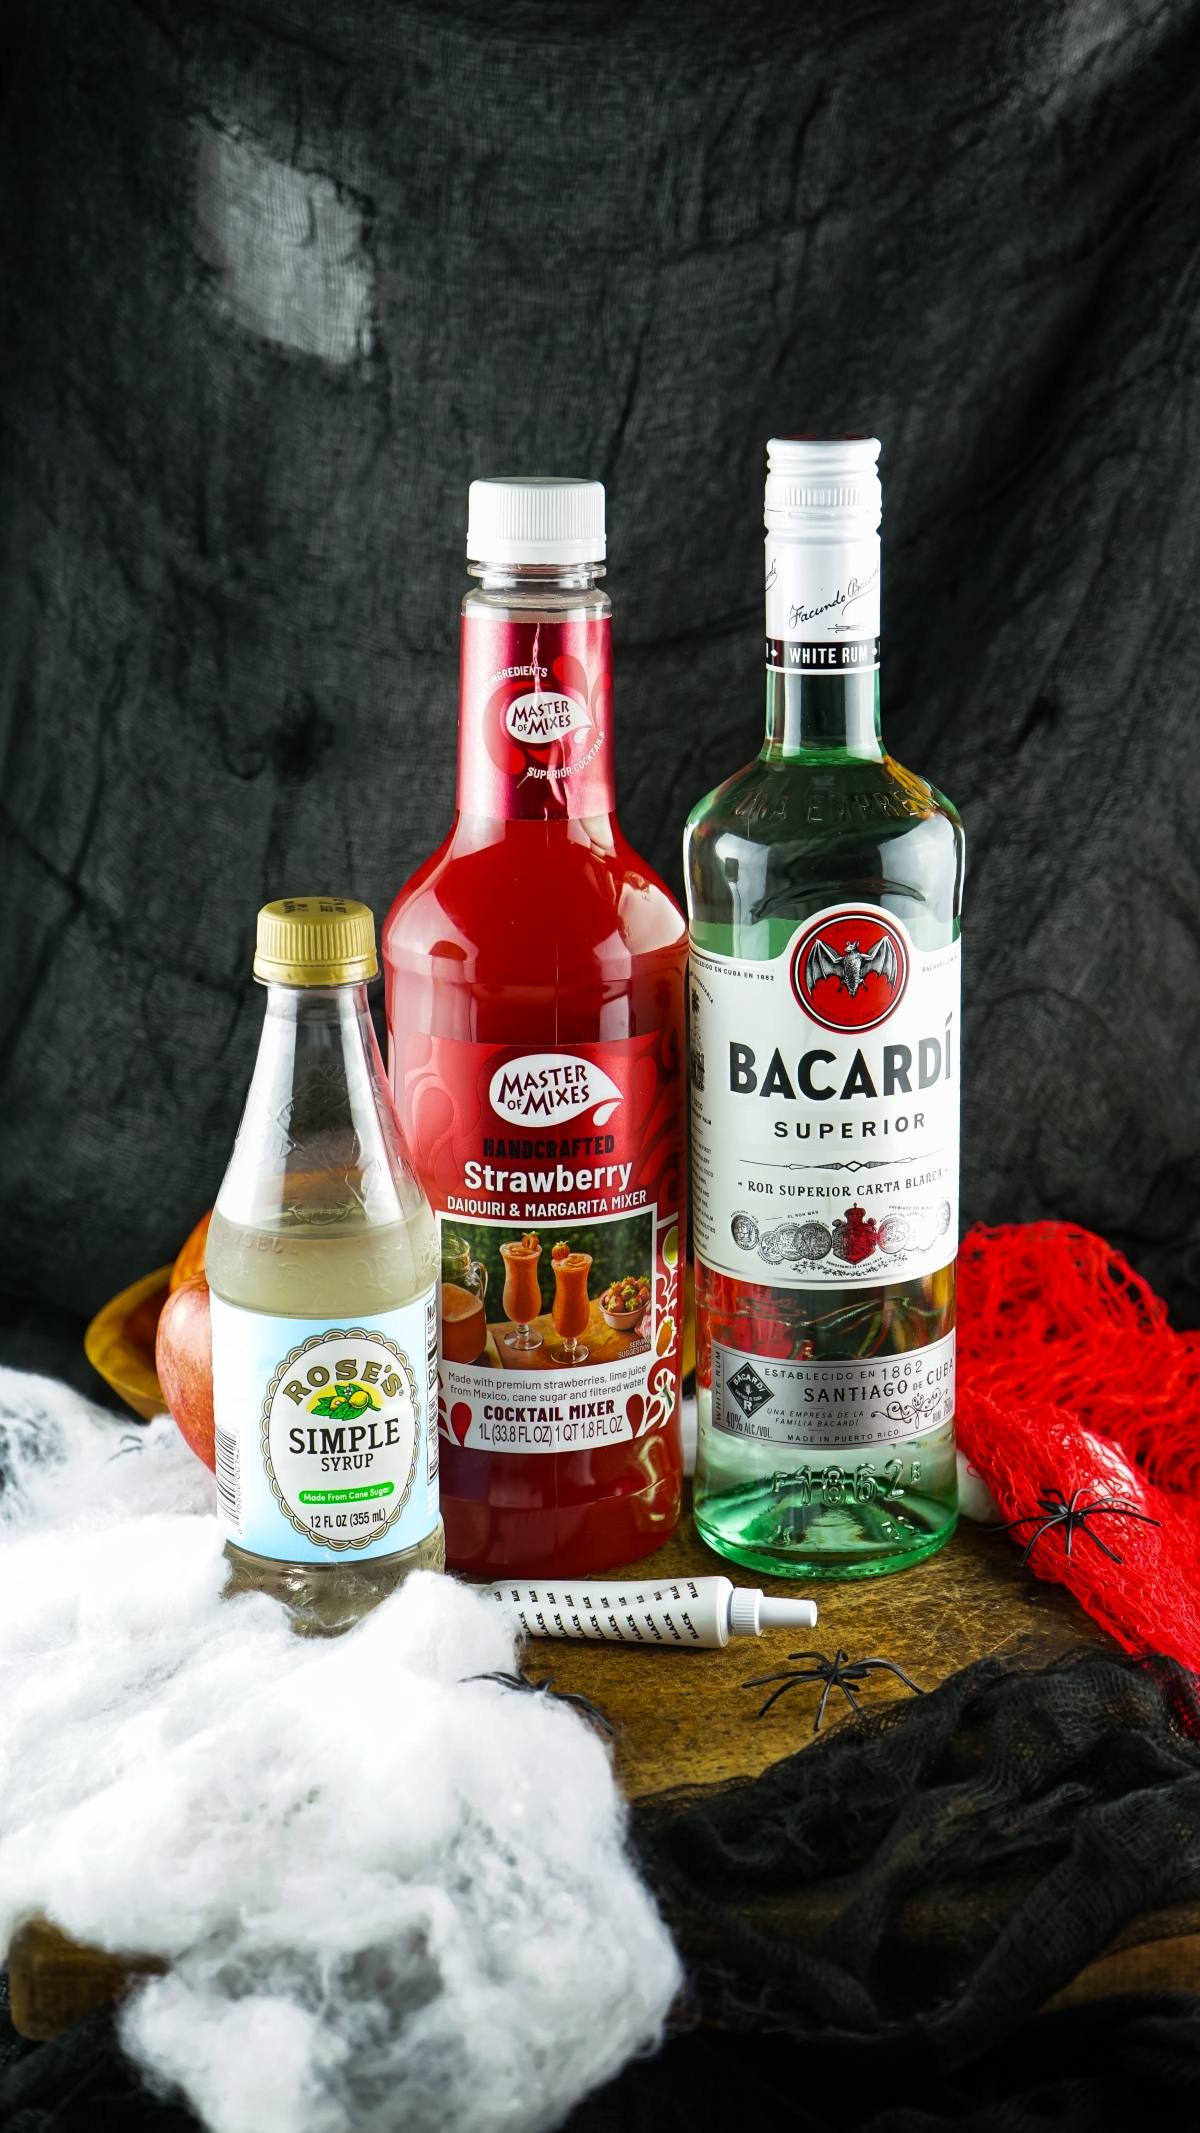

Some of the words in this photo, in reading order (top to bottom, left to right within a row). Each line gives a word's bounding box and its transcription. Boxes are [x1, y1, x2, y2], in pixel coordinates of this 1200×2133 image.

[788, 590, 846, 629] Facundo
[789, 647, 836, 664] WHITE
[842, 646, 868, 663] RUM
[488, 665, 548, 684] INGREDIENTS
[511, 700, 570, 727] MASTER
[517, 724, 528, 732] OF
[527, 715, 571, 736] MIXES
[527, 766, 573, 780] SUPERIOR
[574, 730, 605, 772] COCKTAILS
[723, 968, 741, 977] CUBA
[729, 1011, 952, 1101] BACARDÍ
[498, 1064, 587, 1103] MASTER
[507, 1099, 522, 1110] OF
[521, 1085, 589, 1116] MIXES
[774, 1112, 925, 1140] SUPERIOR
[483, 1135, 615, 1159] HANDCRAFTED
[464, 1160, 633, 1193] Strawberry
[779, 1184, 851, 1198] SUPERIOR
[856, 1181, 900, 1196] CARTA
[905, 1168, 942, 1189] BLANCA
[447, 1196, 506, 1217] DAIQUIRI
[510, 1204, 520, 1217] &
[525, 1199, 608, 1217] MARGARITA
[611, 1189, 647, 1210] MIXER
[618, 1344, 650, 1359] SUGGESTION
[282, 1359, 402, 1405] ROSE'S
[448, 1371, 471, 1385] Made
[474, 1375, 493, 1388] with
[496, 1379, 541, 1392] premium
[543, 1375, 608, 1390] strawberries,
[609, 1370, 627, 1382] lime
[628, 1363, 647, 1380] juice
[764, 1368, 854, 1381] ESTABLECIDO
[861, 1370, 875, 1379] EN
[881, 1360, 923, 1381] 1862
[804, 1379, 908, 1402] SANTIAGO
[913, 1381, 923, 1390] DE
[927, 1358, 953, 1385] CUBA
[450, 1385, 471, 1397] from
[473, 1389, 510, 1402] Mexico,
[512, 1393, 537, 1402] cane
[539, 1393, 567, 1404] sugar
[569, 1389, 587, 1400] and
[589, 1383, 622, 1397] filtered
[623, 1378, 645, 1390] water
[483, 1405, 563, 1423] COCKTAIL
[569, 1399, 615, 1420] MIXER
[743, 1400, 753, 1412] R
[766, 1408, 785, 1416] UNA
[789, 1410, 833, 1419] EMPRESA
[837, 1411, 849, 1419] DE
[853, 1410, 864, 1418] LA
[518, 1425, 531, 1443] FL
[533, 1425, 553, 1447] OZ)
[556, 1425, 560, 1442] 1
[563, 1423, 578, 1441] QT
[581, 1421, 595, 1439] 1.8
[596, 1419, 608, 1436] FL
[609, 1415, 623, 1434] OZ
[726, 1410, 743, 1432] 40%
[775, 1418, 812, 1427] FAMILIA
[288, 1418, 401, 1455] SIMPLE
[787, 1434, 813, 1443] MADE
[819, 1435, 830, 1443] IN
[834, 1434, 873, 1443] PUERTO
[877, 1429, 899, 1438] RICO
[321, 1453, 374, 1472] SYRUP
[303, 1493, 326, 1502] Made
[328, 1493, 347, 1501] From
[349, 1491, 369, 1499] Cane
[370, 1486, 391, 1497] Sugar
[794, 1458, 905, 1507] 1862
[310, 1515, 321, 1528] 12
[324, 1515, 333, 1528] FL
[336, 1514, 347, 1528] OZ
[350, 1511, 370, 1528] (355
[372, 1507, 386, 1523] mL)
[645, 1613, 663, 1640] BLACK
[663, 1612, 681, 1640] BLACK
[681, 1611, 699, 1640] BLACK
